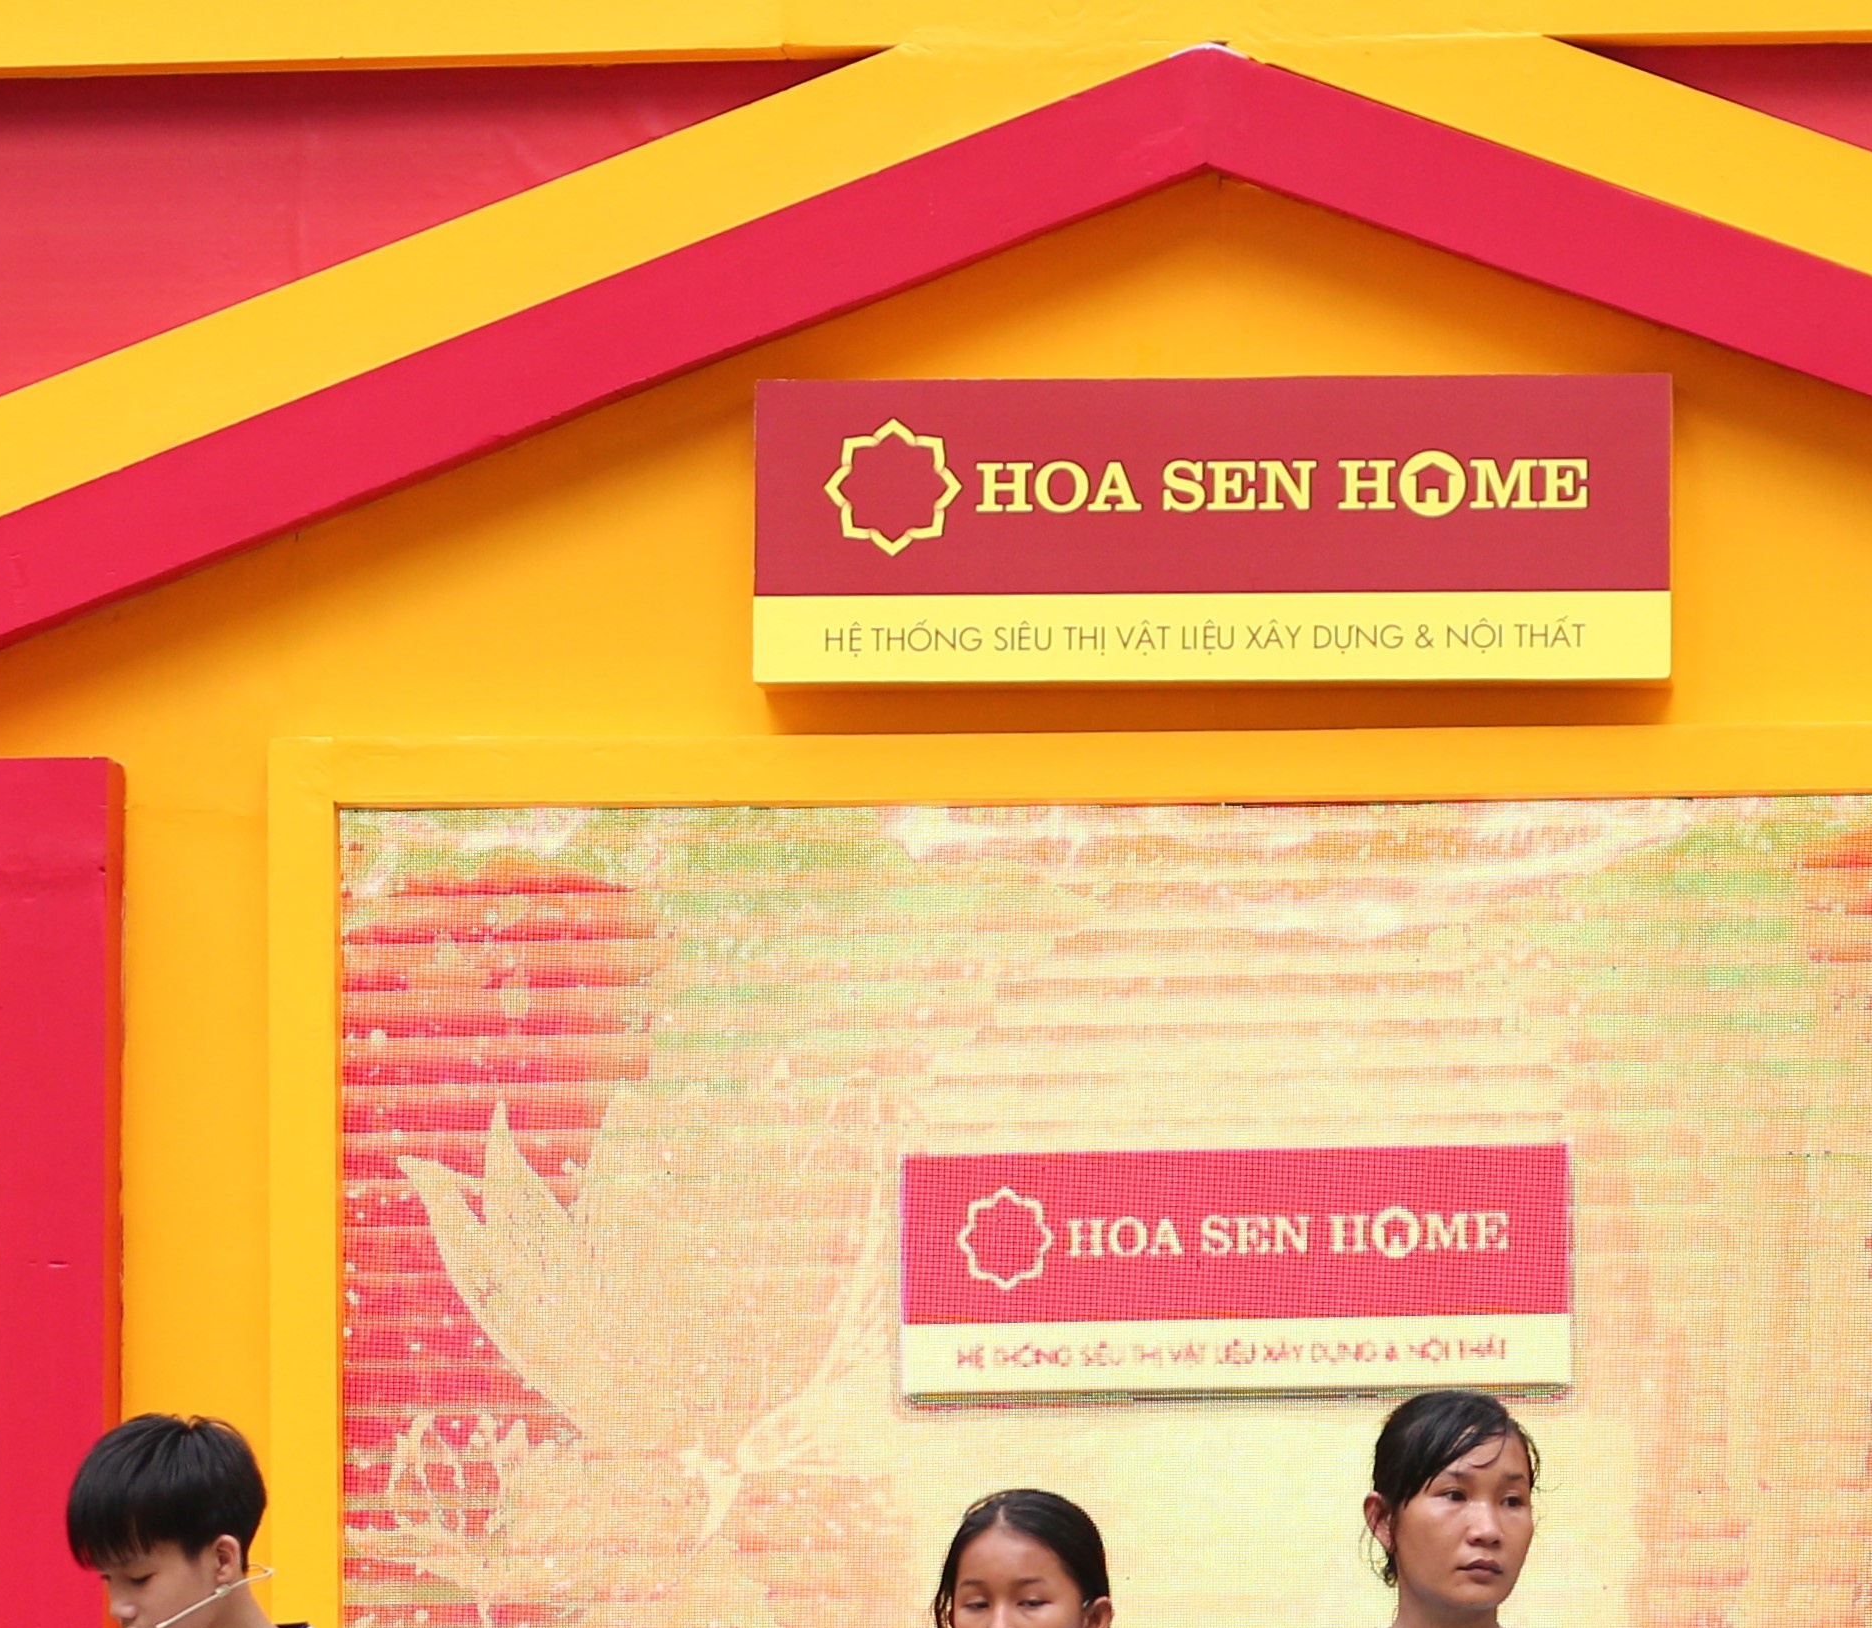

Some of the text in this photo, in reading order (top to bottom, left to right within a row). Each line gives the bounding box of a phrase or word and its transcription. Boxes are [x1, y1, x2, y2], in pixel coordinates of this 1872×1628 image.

[974, 449, 1590, 518] HOA SEN HOME
[824, 615, 1586, 658] HỆ THỐNG SIÊU THỊ VẬT LIỆU XÂY DỰNG & NỘI THẤT
[1067, 1205, 1510, 1260] HOA SEN HOME
